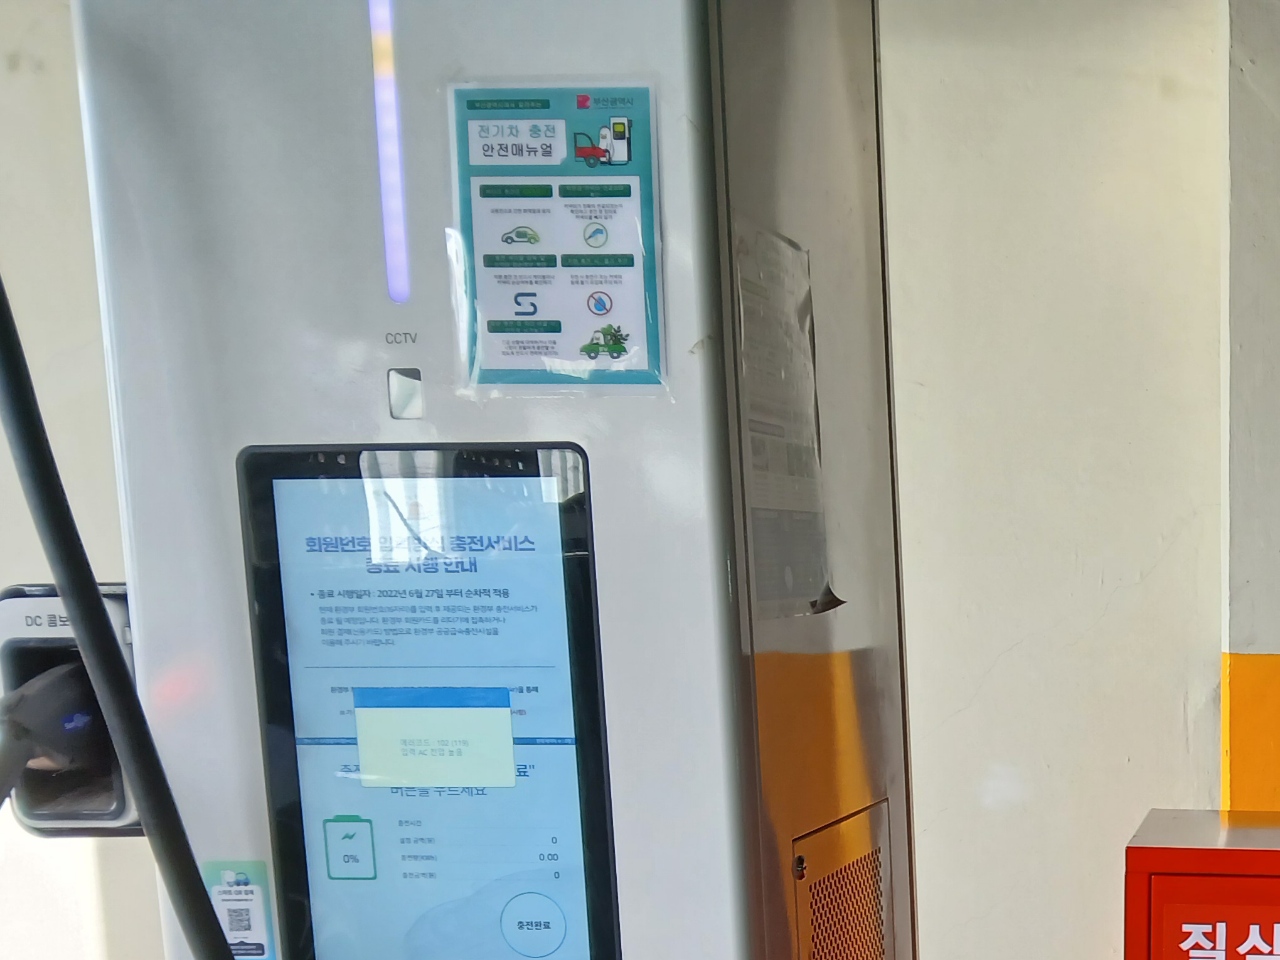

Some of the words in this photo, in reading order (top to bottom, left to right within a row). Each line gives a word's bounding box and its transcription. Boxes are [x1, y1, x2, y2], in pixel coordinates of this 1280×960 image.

[593, 97, 634, 106] 부산광역시
[478, 124, 520, 138] 전기차
[529, 124, 556, 138] 충전
[482, 143, 552, 157] 안전매뉴얼
[385, 332, 417, 344] CCTV
[305, 536, 371, 552] 회원번호
[450, 535, 535, 552] 충전서비스
[405, 556, 439, 573] 시행
[443, 557, 478, 573] 안내
[317, 589, 335, 599] 종료
[376, 589, 407, 599] 2022년
[408, 588, 423, 599] 6월
[425, 588, 444, 599] 27일
[445, 588, 463, 598] 부터
[464, 588, 491, 598] 순차적
[492, 588, 510, 599] 적용
[25, 615, 43, 627] DC
[46, 614, 70, 627] 콤보
[551, 836, 558, 844] 0
[342, 854, 360, 864] 0%
[538, 853, 559, 861] 0.00
[553, 871, 561, 879] 0
[517, 920, 552, 931] 충전완료
